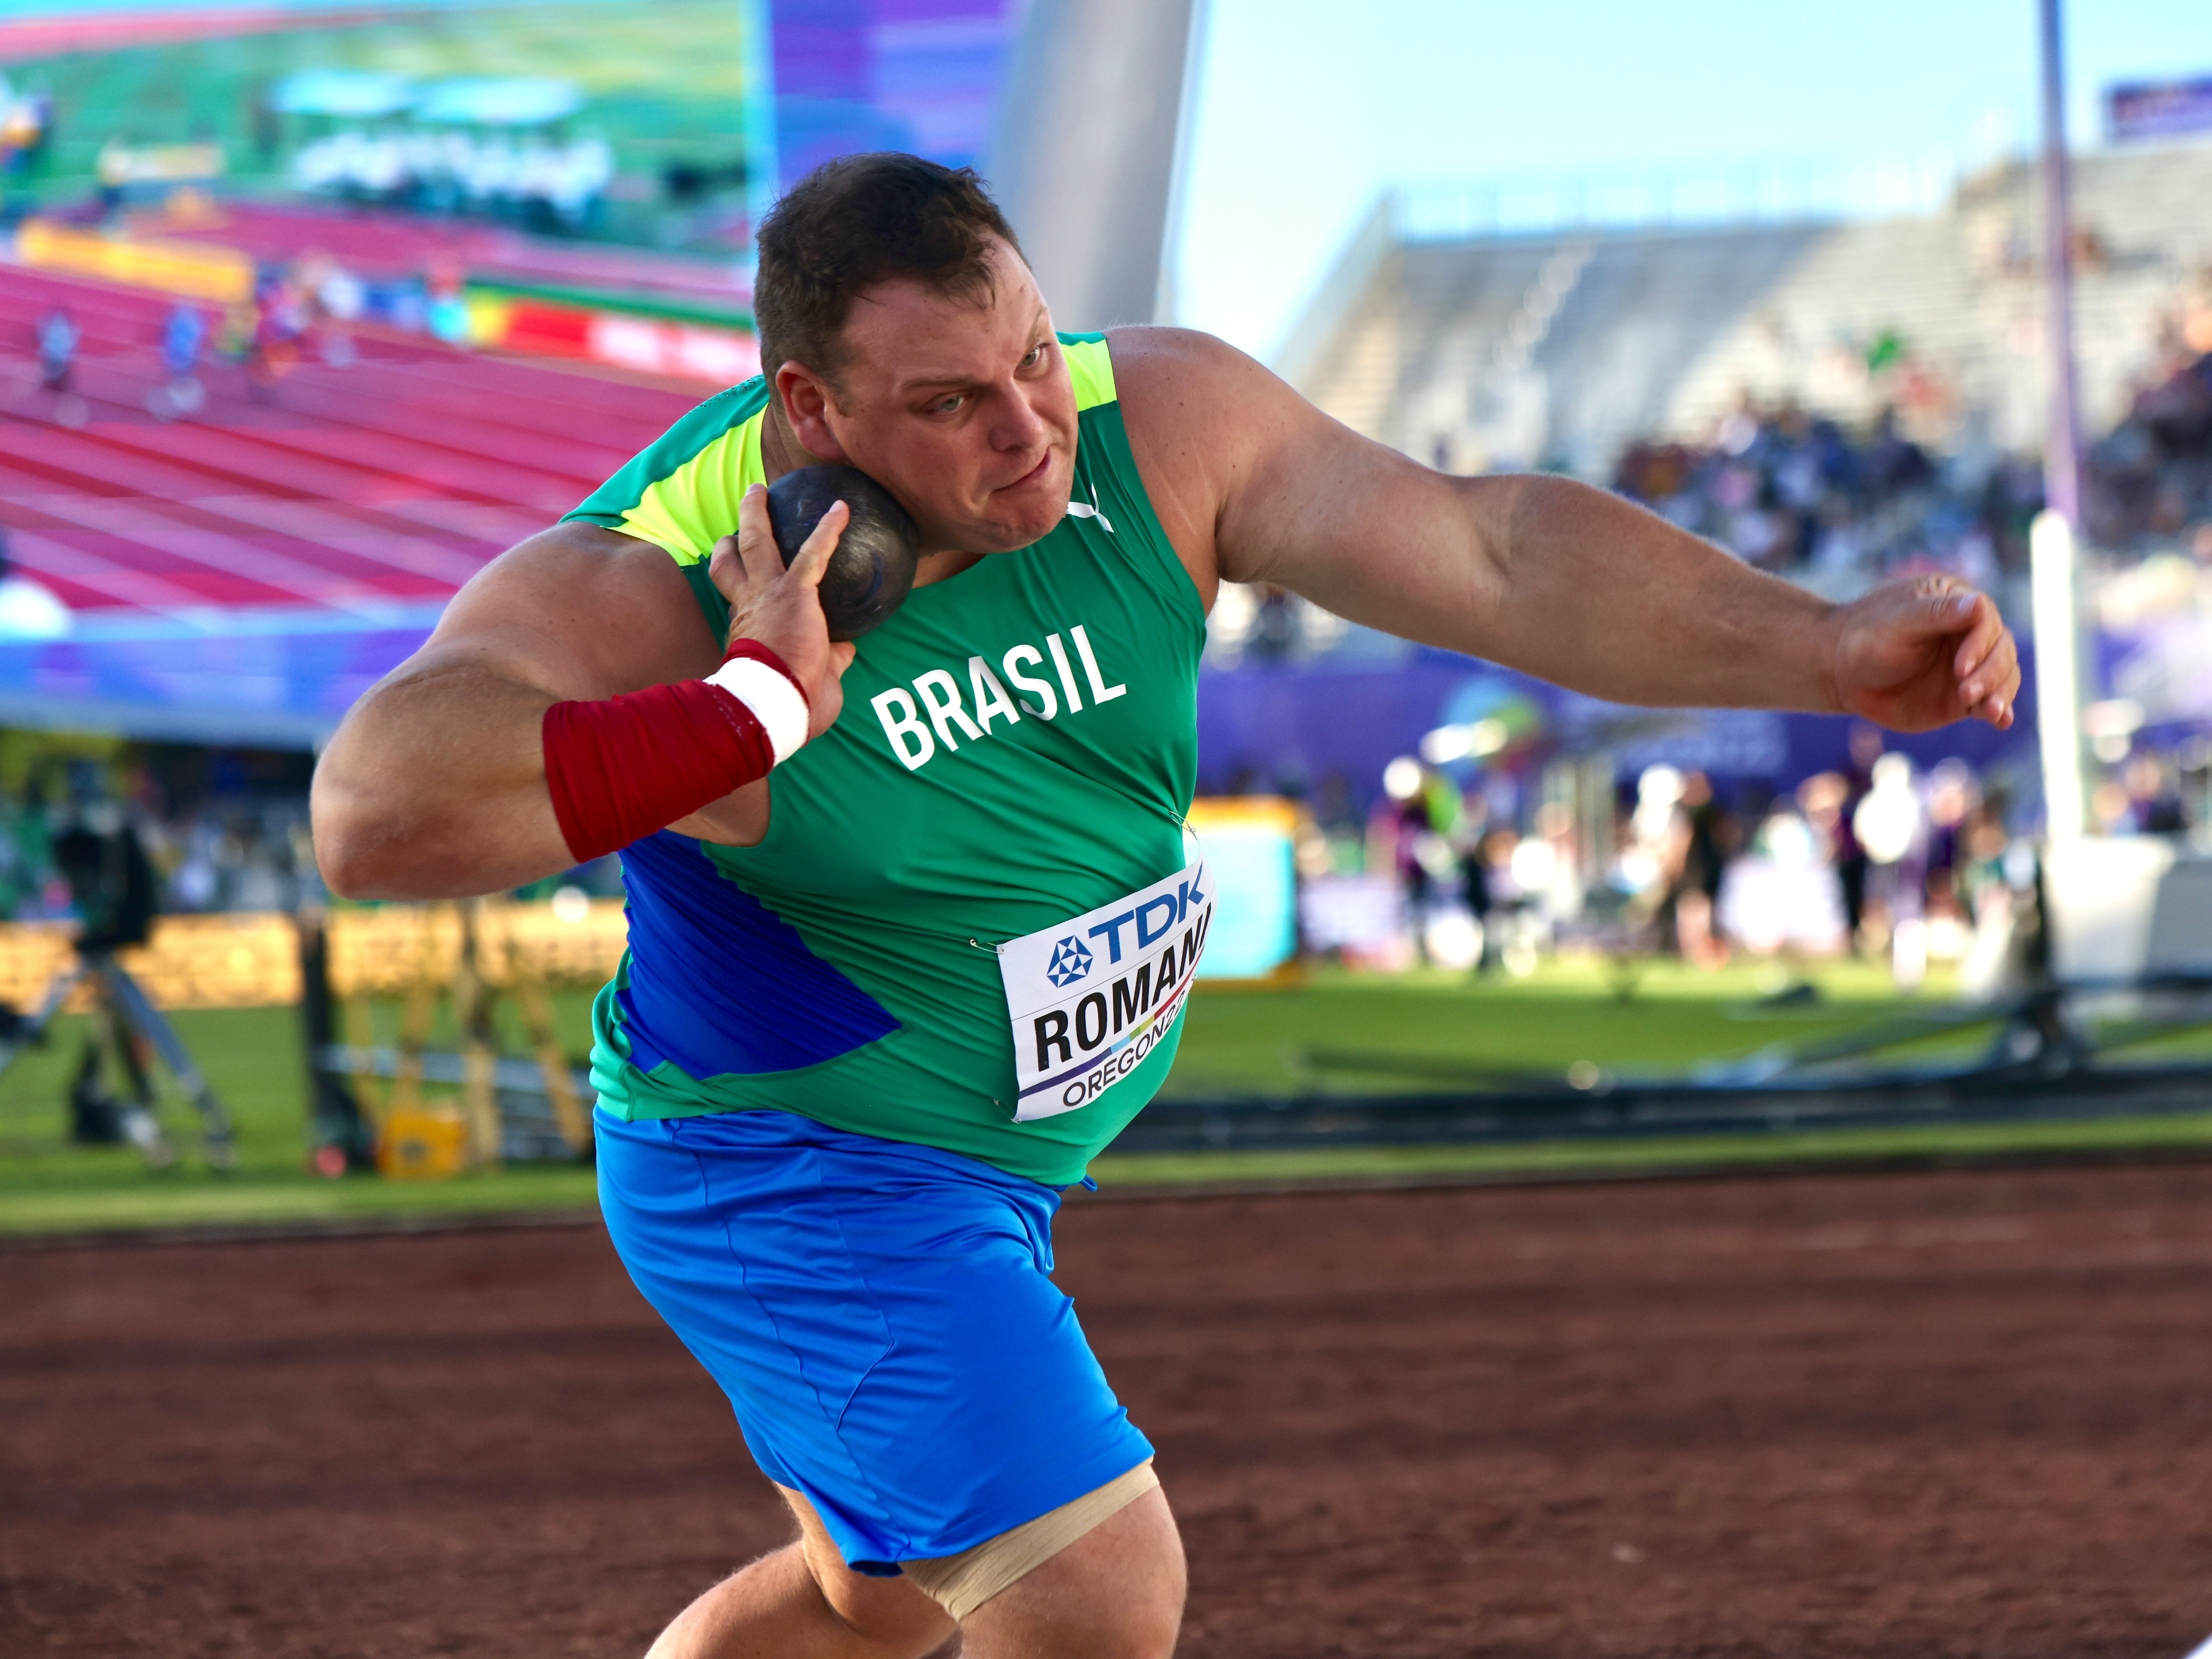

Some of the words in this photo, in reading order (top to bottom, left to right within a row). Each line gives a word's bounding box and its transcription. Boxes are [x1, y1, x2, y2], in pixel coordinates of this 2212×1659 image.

[870, 625, 1126, 771] BRASIL
[1089, 859, 1205, 965] TDK
[1034, 901, 1212, 1072] ROMANI
[1063, 990, 1185, 1107] OREGON22
